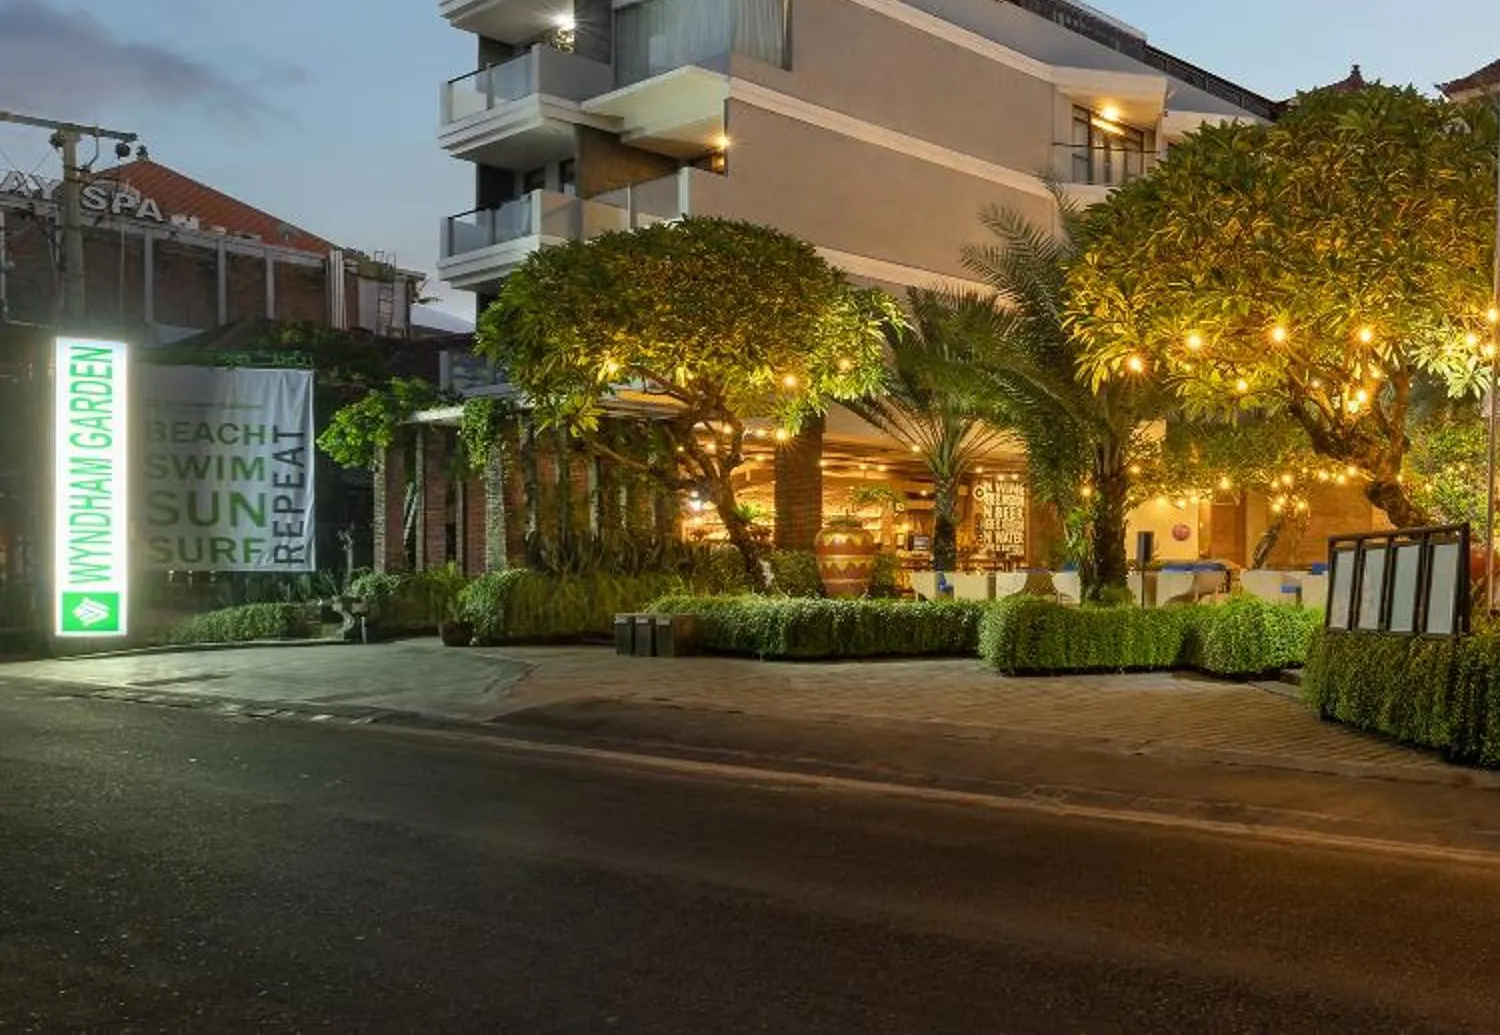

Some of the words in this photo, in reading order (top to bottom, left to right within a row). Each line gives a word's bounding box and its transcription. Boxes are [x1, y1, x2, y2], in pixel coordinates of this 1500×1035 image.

[80, 180, 164, 222] SPA
[69, 346, 113, 451] GARDEN
[146, 421, 266, 445] BEACH
[144, 453, 265, 481] SWIM
[147, 490, 266, 527] SUN
[272, 425, 305, 564] REPEAT
[68, 457, 113, 584] WYNDHAM
[148, 535, 266, 564] SURF
